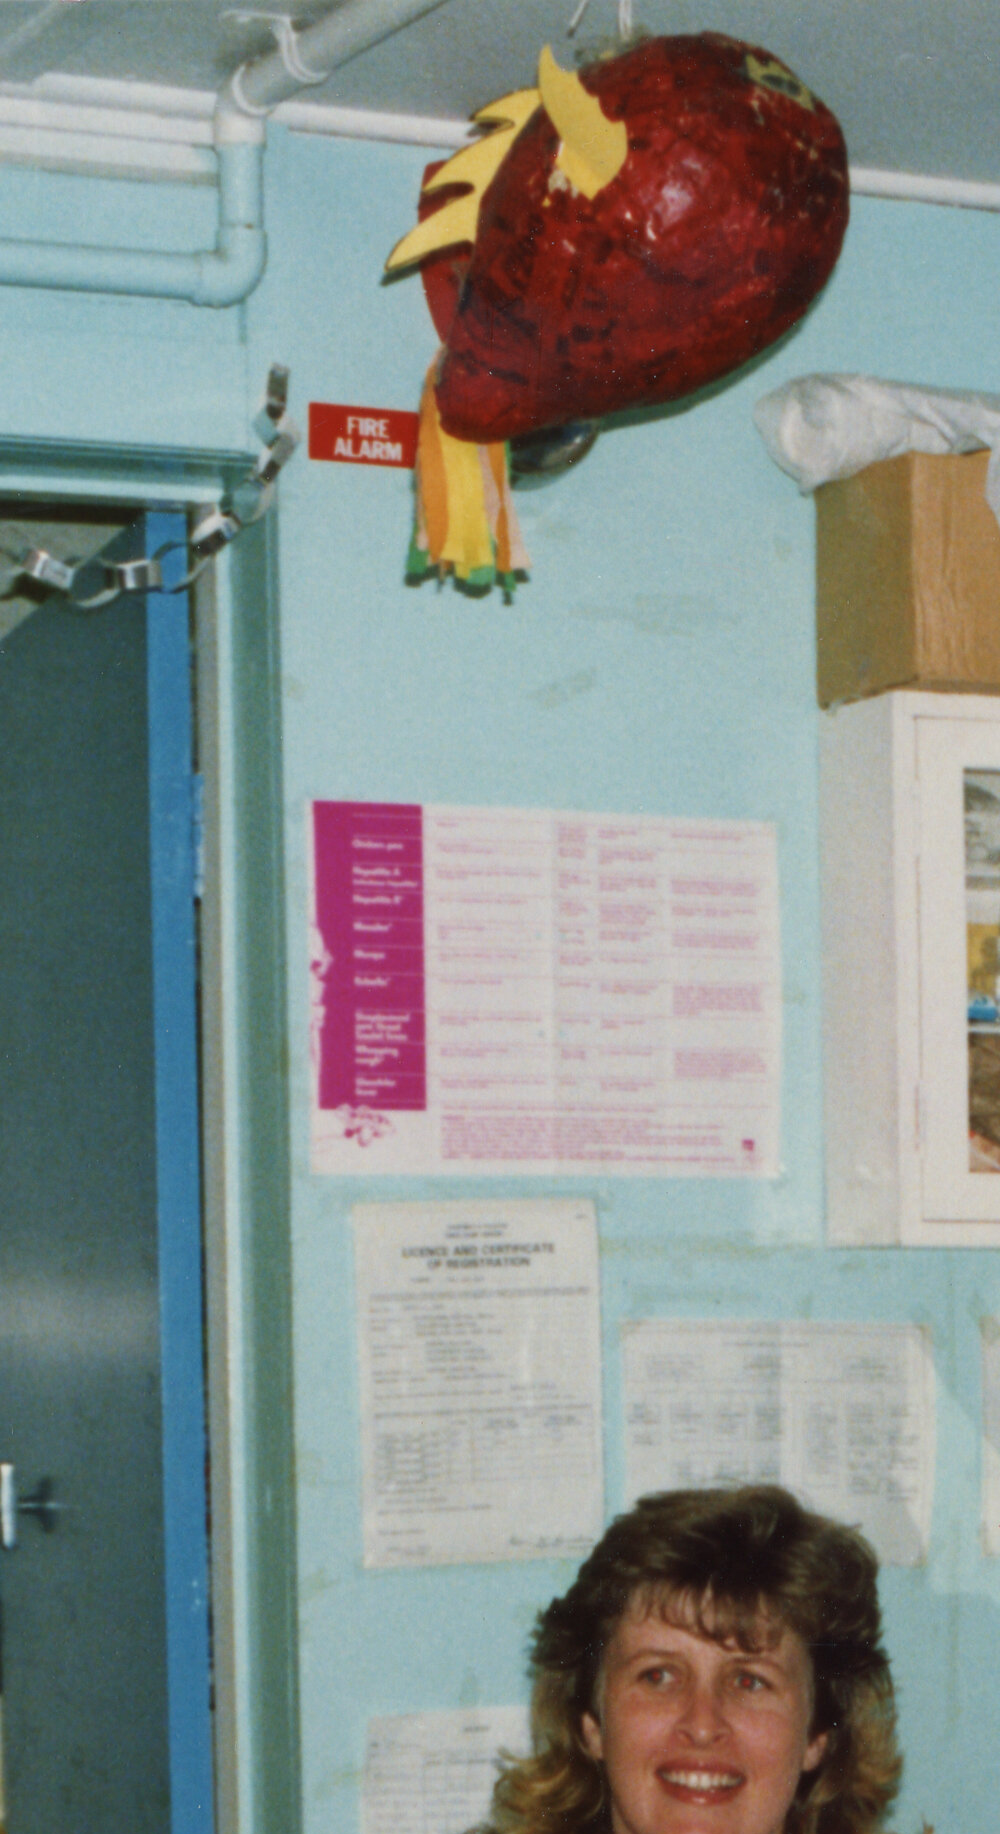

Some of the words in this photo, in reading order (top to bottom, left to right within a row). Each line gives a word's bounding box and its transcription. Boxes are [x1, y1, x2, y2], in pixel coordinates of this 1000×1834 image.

[346, 416, 390, 439] FIRE
[334, 437, 402, 461] ALARM
[402, 1246, 448, 1258] LICENCE
[453, 1244, 478, 1257] AND
[481, 1242, 556, 1256] CERTIFICATE
[427, 1258, 442, 1269] OF
[446, 1256, 531, 1269] REGISTRATION
